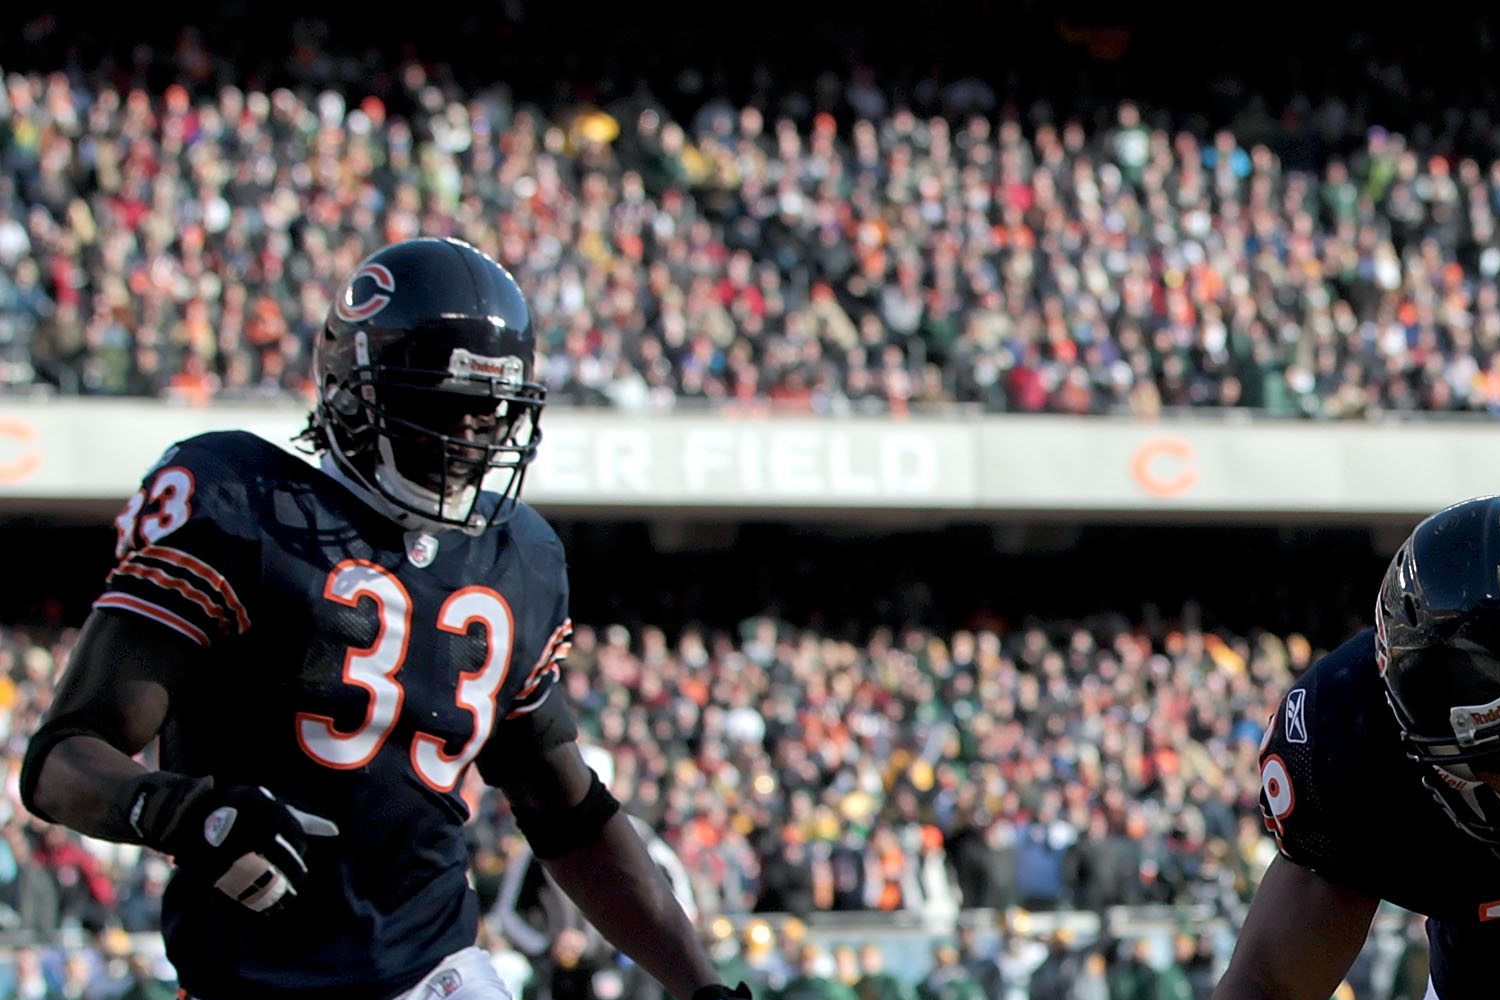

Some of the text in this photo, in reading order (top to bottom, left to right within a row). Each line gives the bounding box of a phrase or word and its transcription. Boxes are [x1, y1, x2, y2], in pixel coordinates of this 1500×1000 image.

[536, 435, 938, 494] ER FIELD
[295, 558, 515, 794] 33
